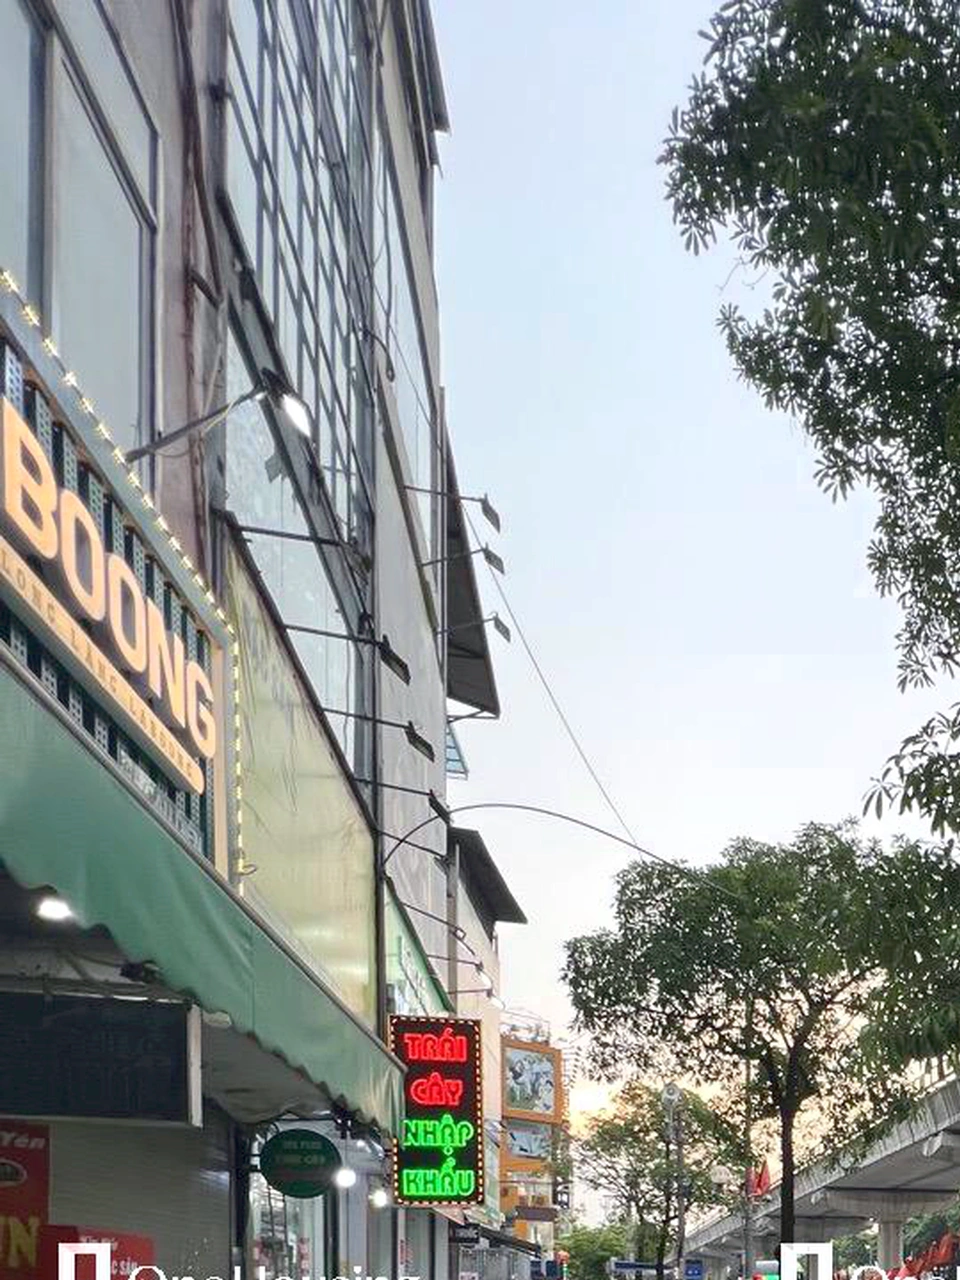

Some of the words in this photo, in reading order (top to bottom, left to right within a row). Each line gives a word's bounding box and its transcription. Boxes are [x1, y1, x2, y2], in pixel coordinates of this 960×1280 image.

[1, 396, 216, 759] BOONG
[403, 1027, 467, 1061] TRÁI
[410, 1072, 463, 1105] CÂY
[403, 1114, 474, 1155] NHẬP
[403, 1157, 475, 1196] KHẨU
